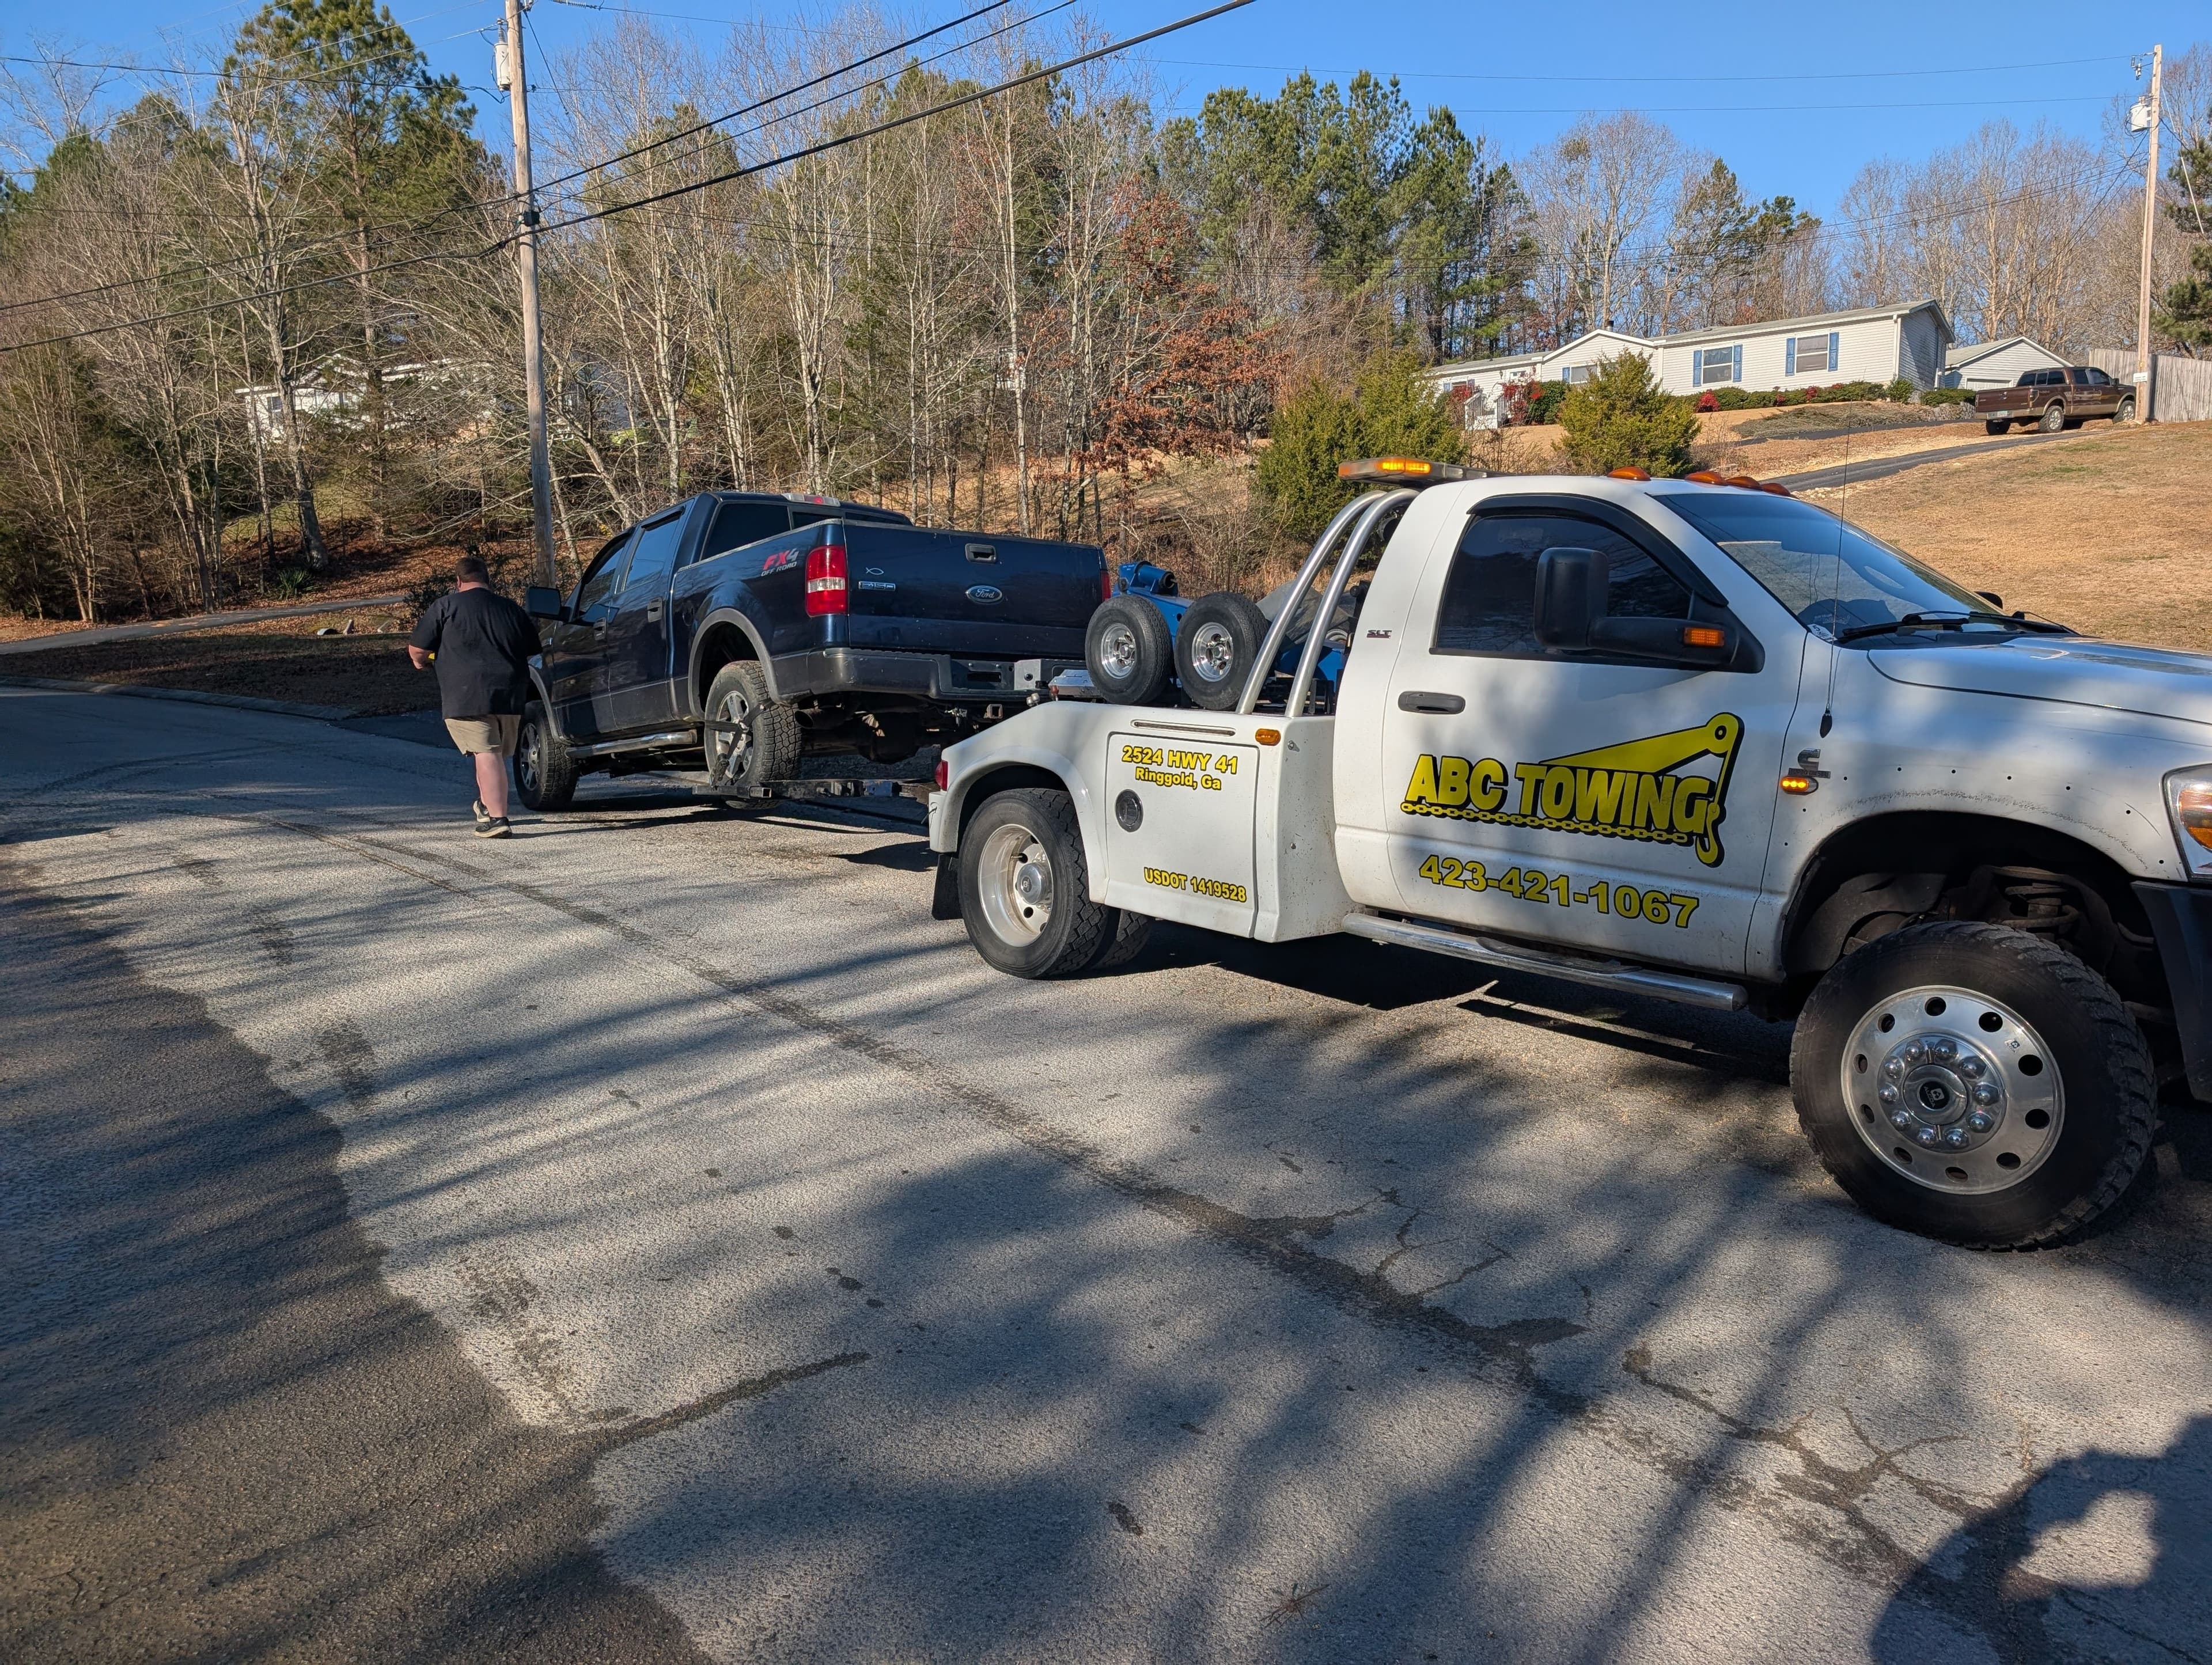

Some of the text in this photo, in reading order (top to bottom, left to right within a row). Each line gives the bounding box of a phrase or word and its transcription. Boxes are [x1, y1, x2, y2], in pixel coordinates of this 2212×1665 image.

[761, 562, 797, 577] OFF ROAD
[763, 548, 799, 570] FX4
[975, 588, 995, 598] Ford
[1122, 745, 1238, 775] 2524 HWY 41
[1135, 767, 1222, 790] Ringgold, Ga
[1404, 754, 1715, 839] ABC TOWING
[1144, 867, 1247, 902] USDOT 1419528
[1419, 855, 1699, 928] 423-421-1067
